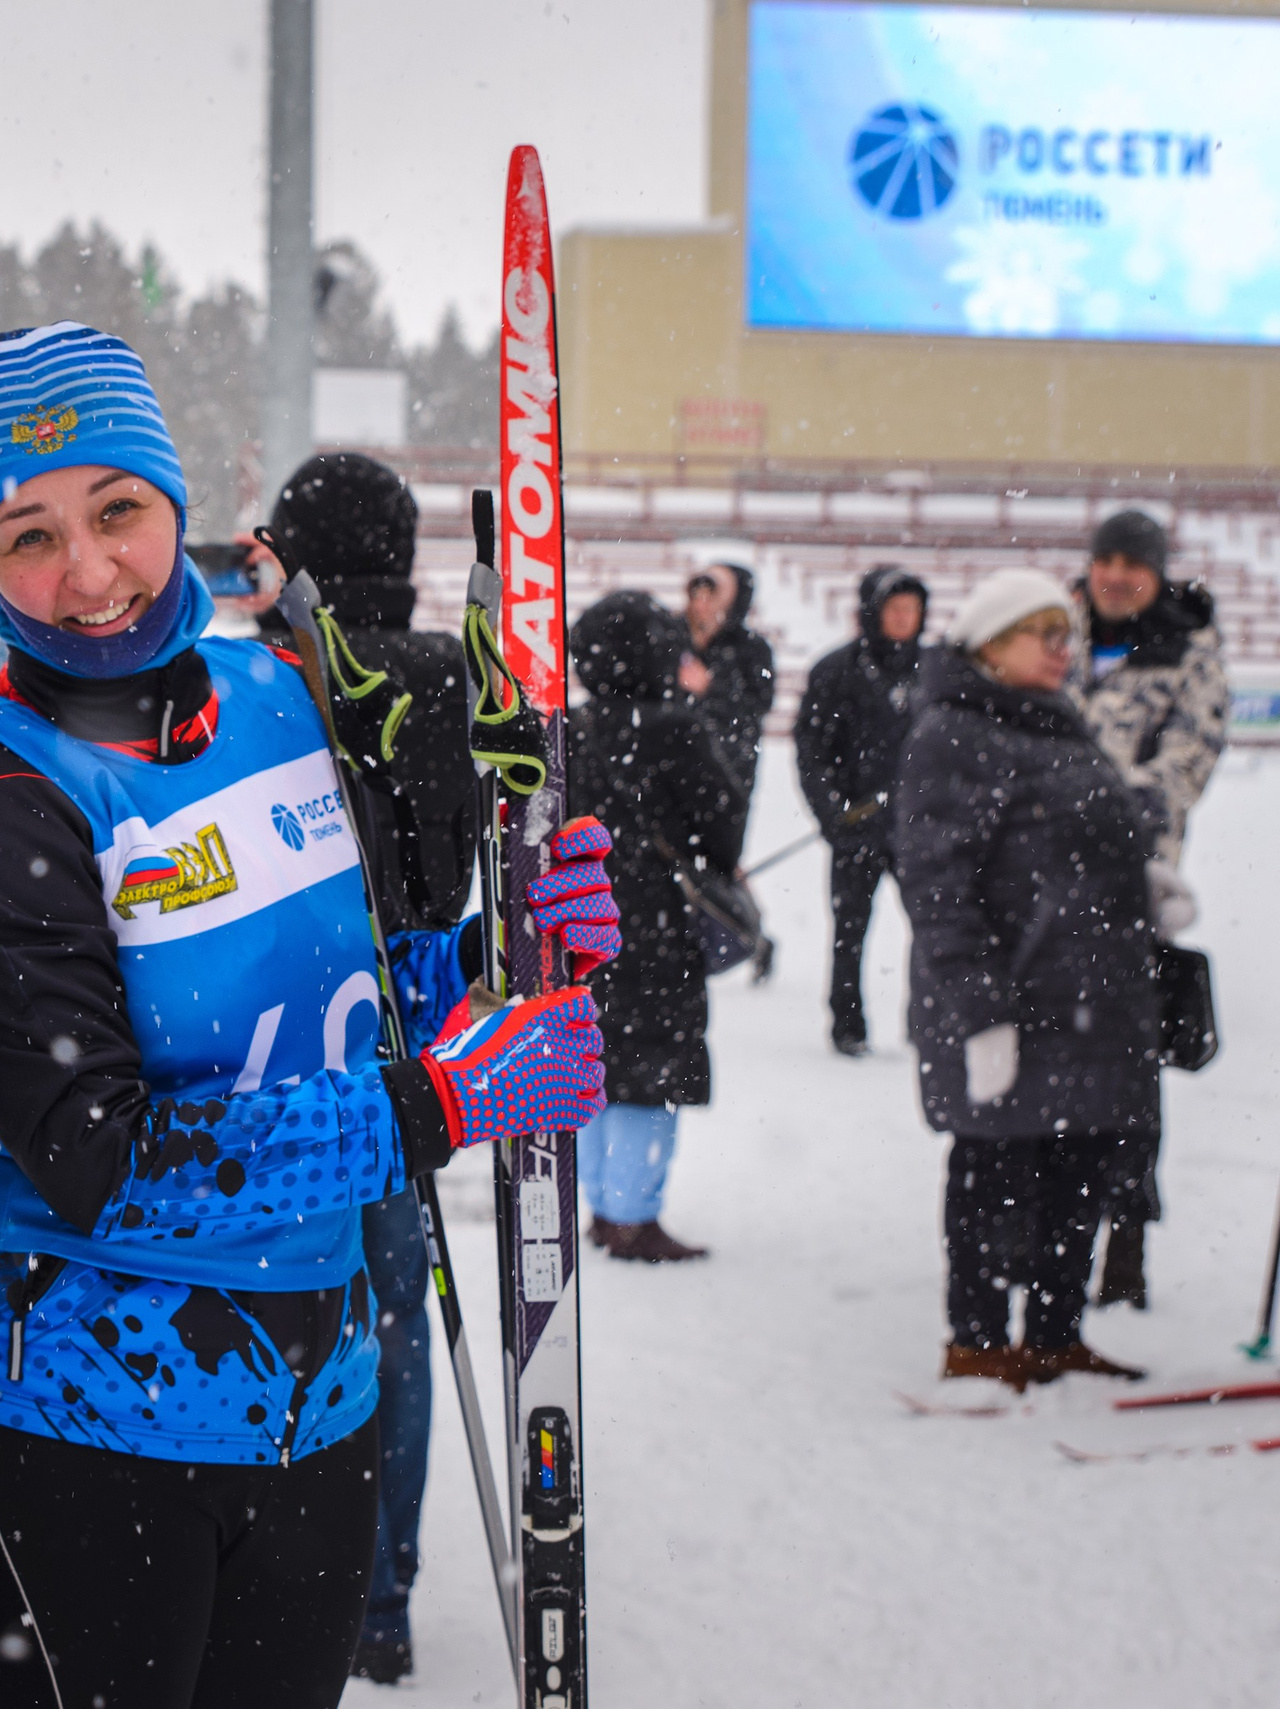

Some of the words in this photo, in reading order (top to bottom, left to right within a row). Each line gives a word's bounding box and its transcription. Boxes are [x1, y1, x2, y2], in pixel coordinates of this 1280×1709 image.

[979, 124, 1213, 178] РОССЕТИ
[983, 189, 1105, 227] ТЮМЕНЬ
[504, 265, 557, 672] ATOMIC
